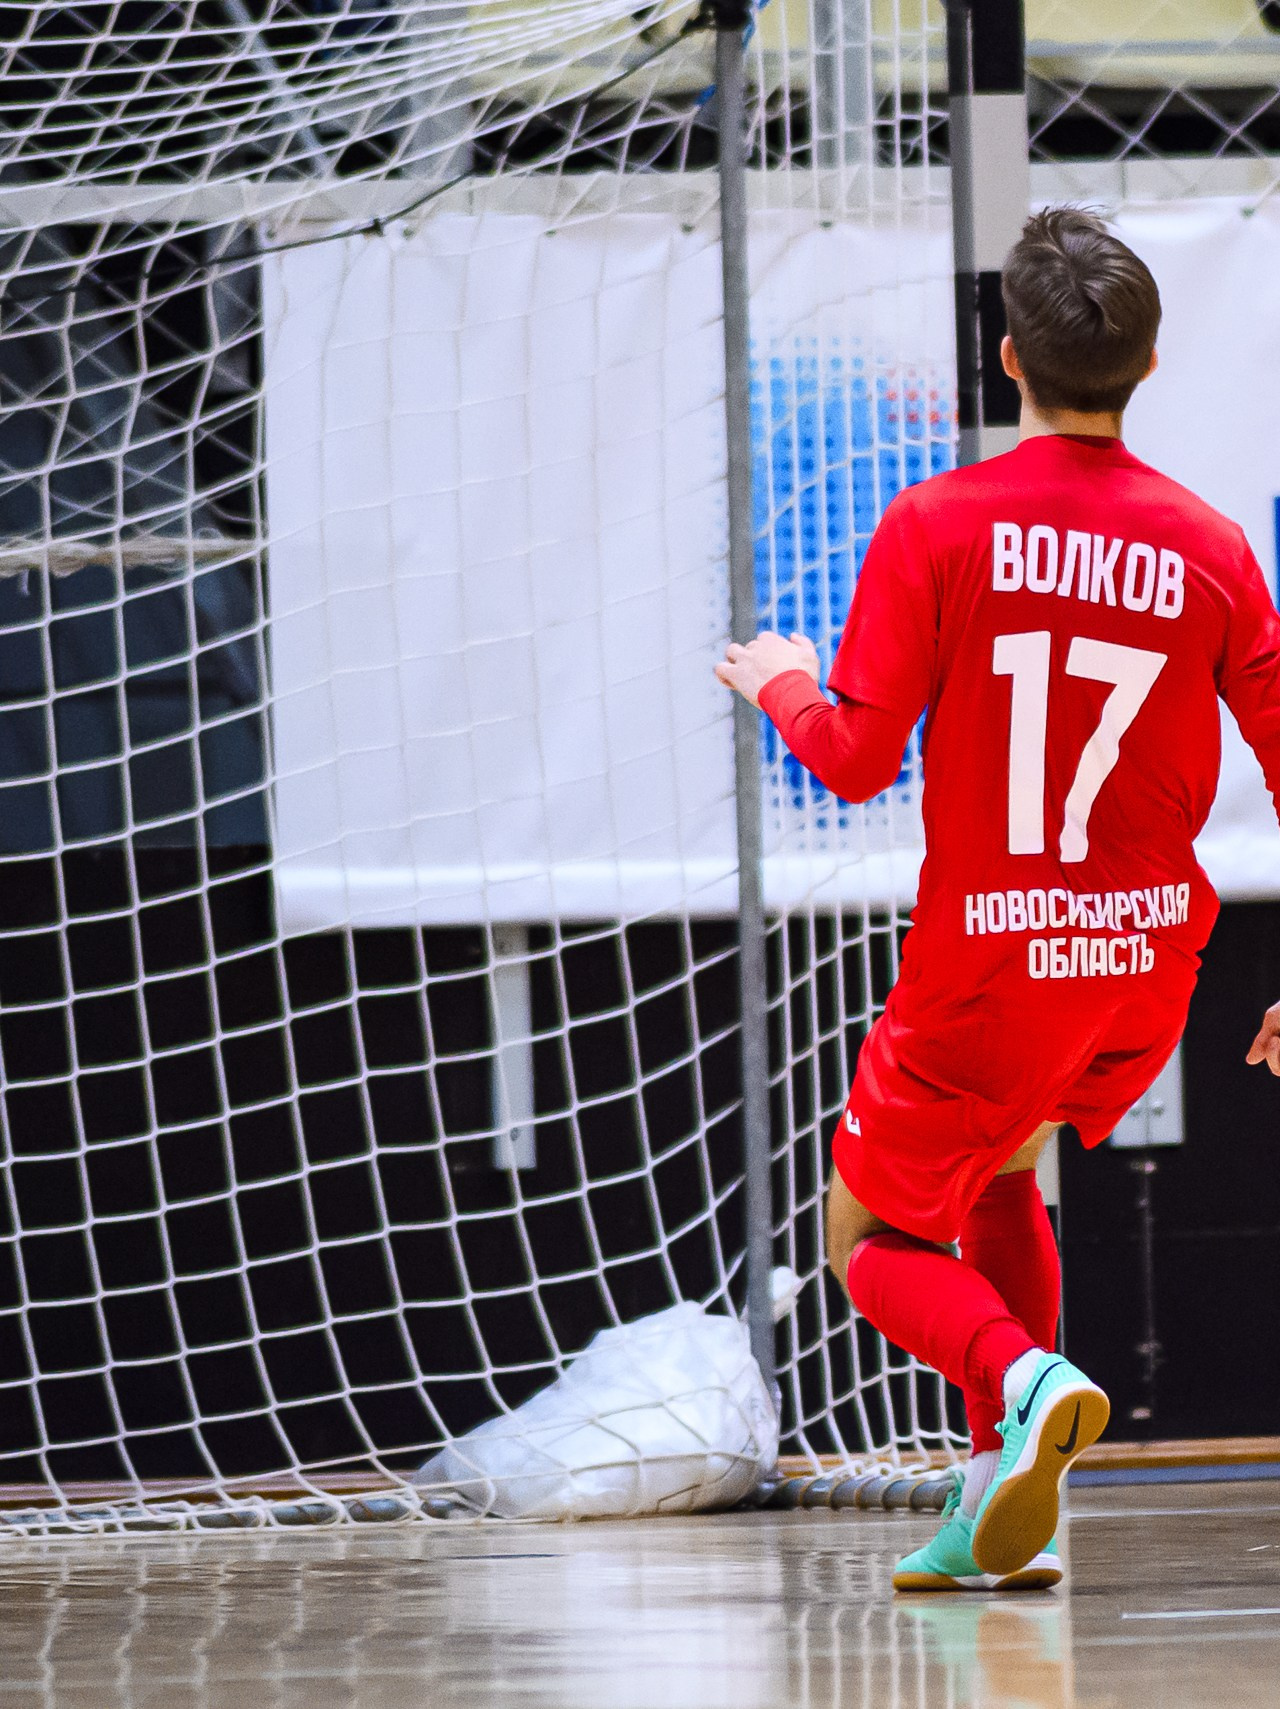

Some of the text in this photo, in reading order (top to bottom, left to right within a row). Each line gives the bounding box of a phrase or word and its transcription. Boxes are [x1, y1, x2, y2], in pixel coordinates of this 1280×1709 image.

[992, 522, 1185, 620] ВОЛКОВ
[992, 630, 1168, 863] 17
[965, 882, 1190, 936] НОВОСИБИРСКАЯ
[1028, 933, 1155, 979] ОБЛАСТЬ
